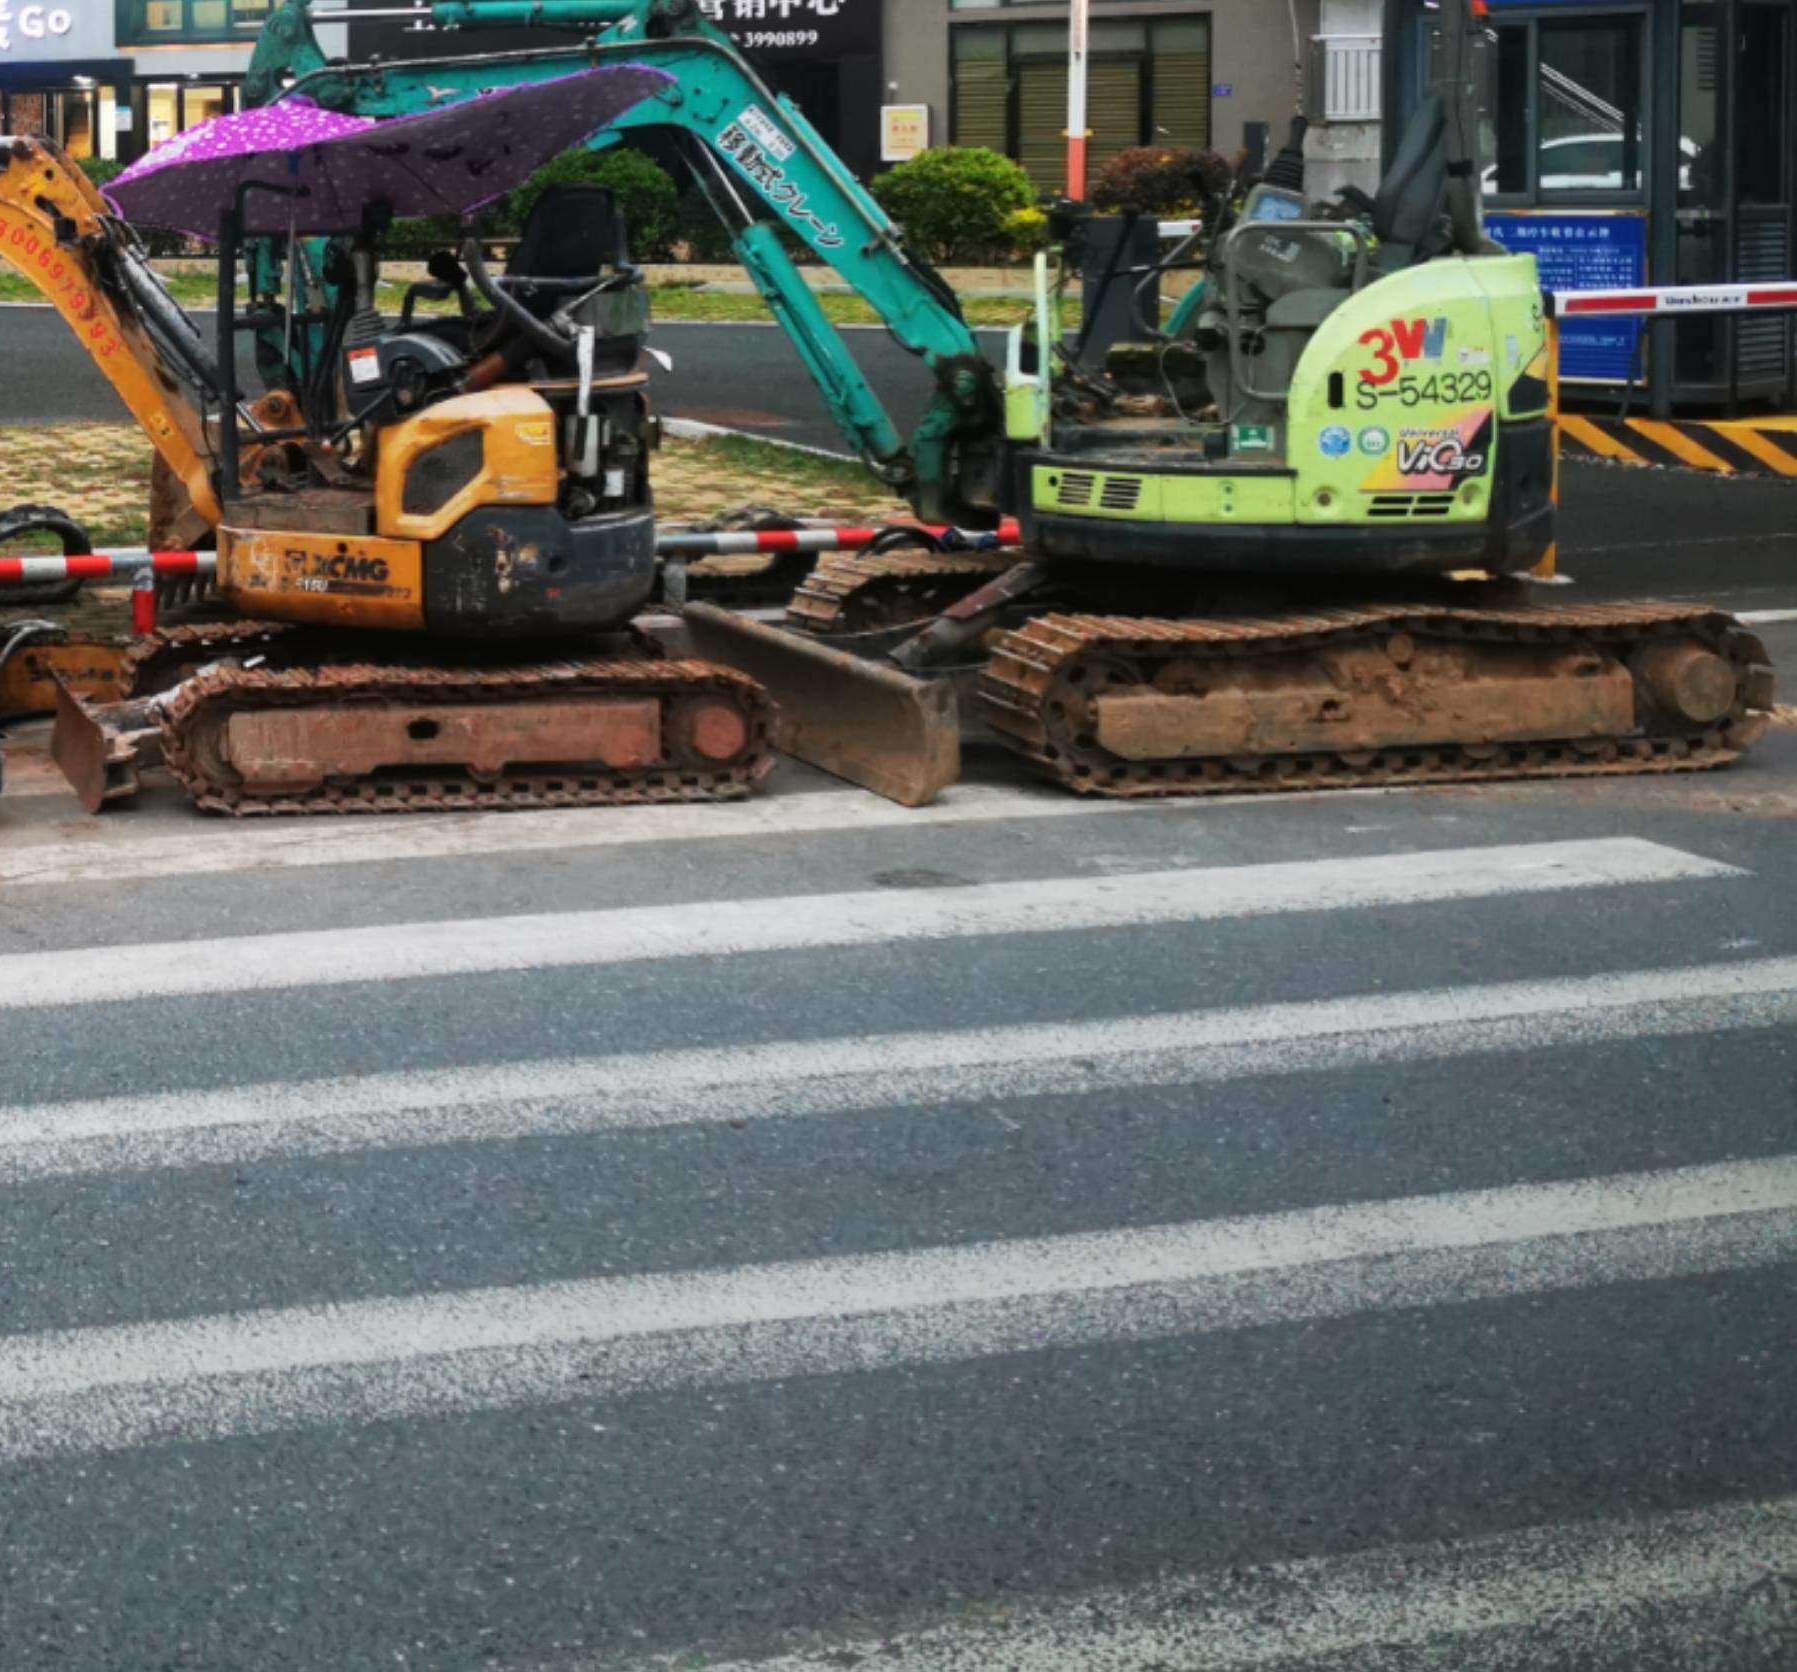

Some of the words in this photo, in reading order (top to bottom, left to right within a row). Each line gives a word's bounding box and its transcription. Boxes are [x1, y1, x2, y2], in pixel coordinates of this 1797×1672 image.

[744, 29, 819, 47] 3990899
[716, 121, 845, 247] 移動式クレーン
[1356, 370, 1492, 410] S-54329
[314, 554, 389, 581] XCMG
